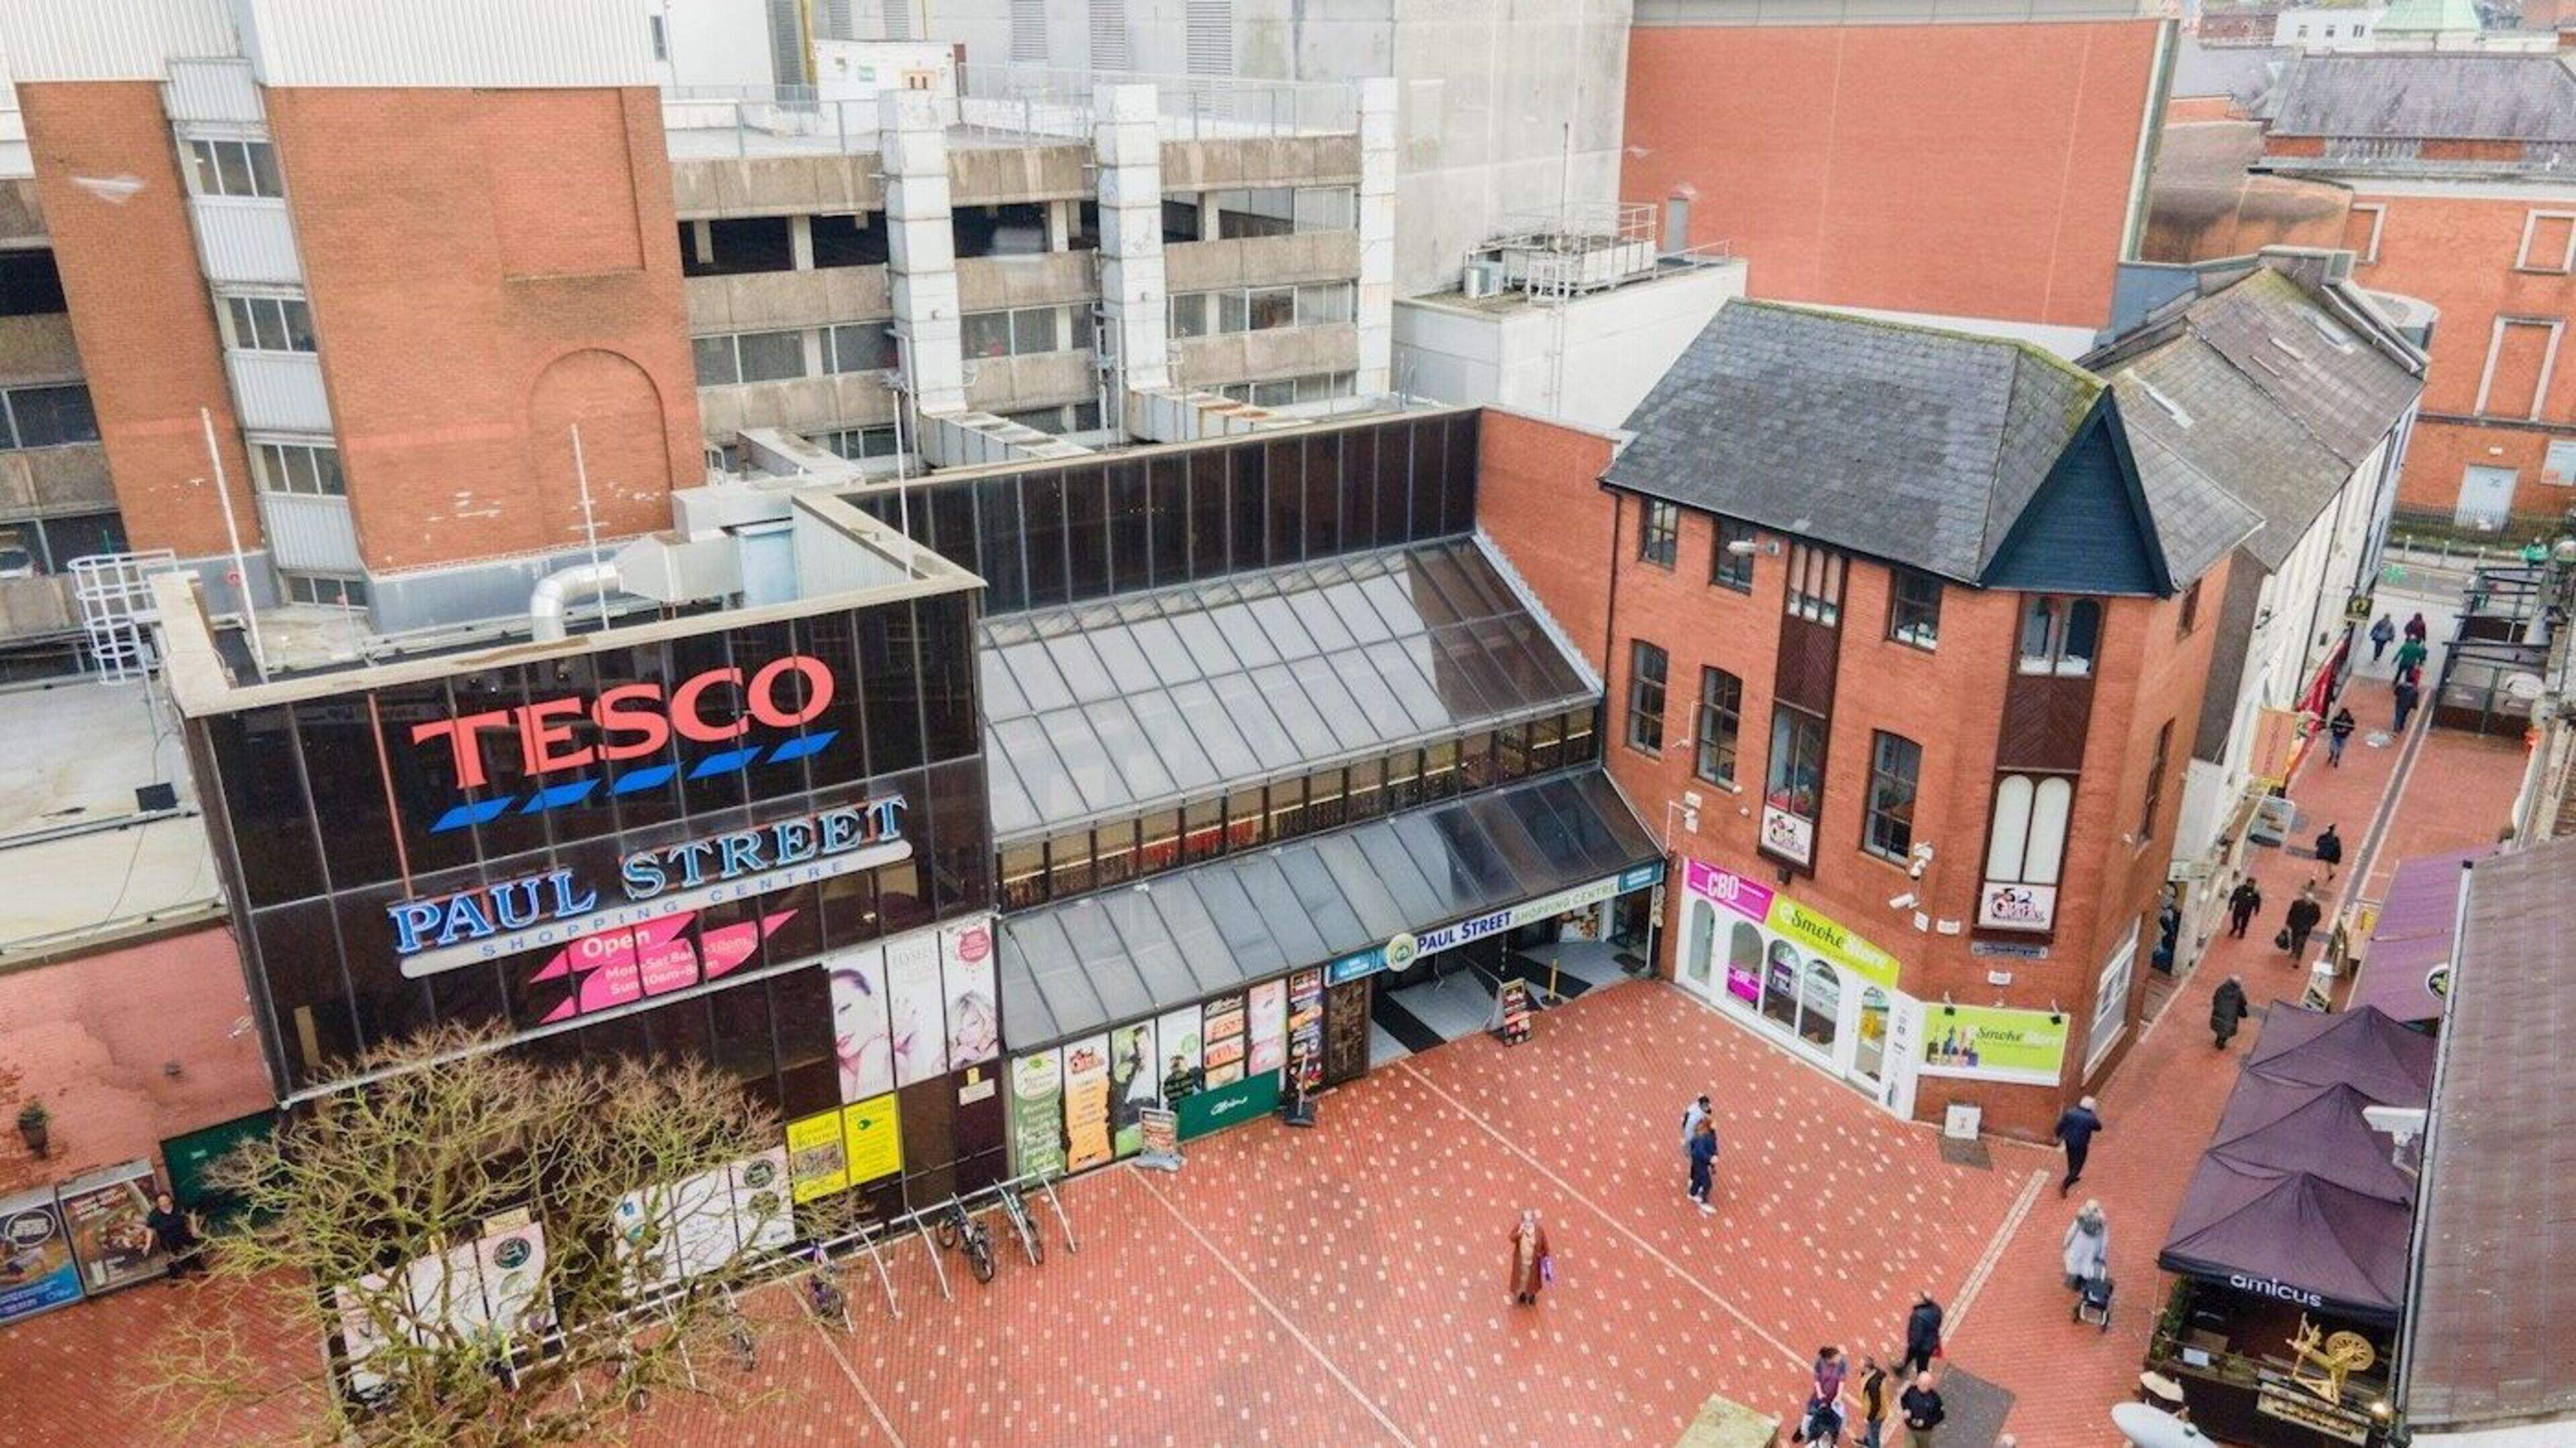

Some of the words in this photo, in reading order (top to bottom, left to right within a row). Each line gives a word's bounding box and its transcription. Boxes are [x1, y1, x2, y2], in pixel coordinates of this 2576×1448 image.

[411, 655, 835, 790] TESCO
[388, 867, 597, 953] PAUL
[621, 795, 909, 899] STREET
[1707, 872, 1739, 901] CBD
[481, 900, 680, 957] SHOPPING
[708, 859, 845, 902] CENTRE
[583, 930, 651, 958] Open
[1417, 930, 1456, 954] PAUL
[1462, 911, 1511, 939] STREET
[1790, 910, 1845, 949] Smoke
[610, 981, 639, 995] Sun
[1977, 1026, 2025, 1042] Smoke
[2231, 1274, 2322, 1307] amicus
